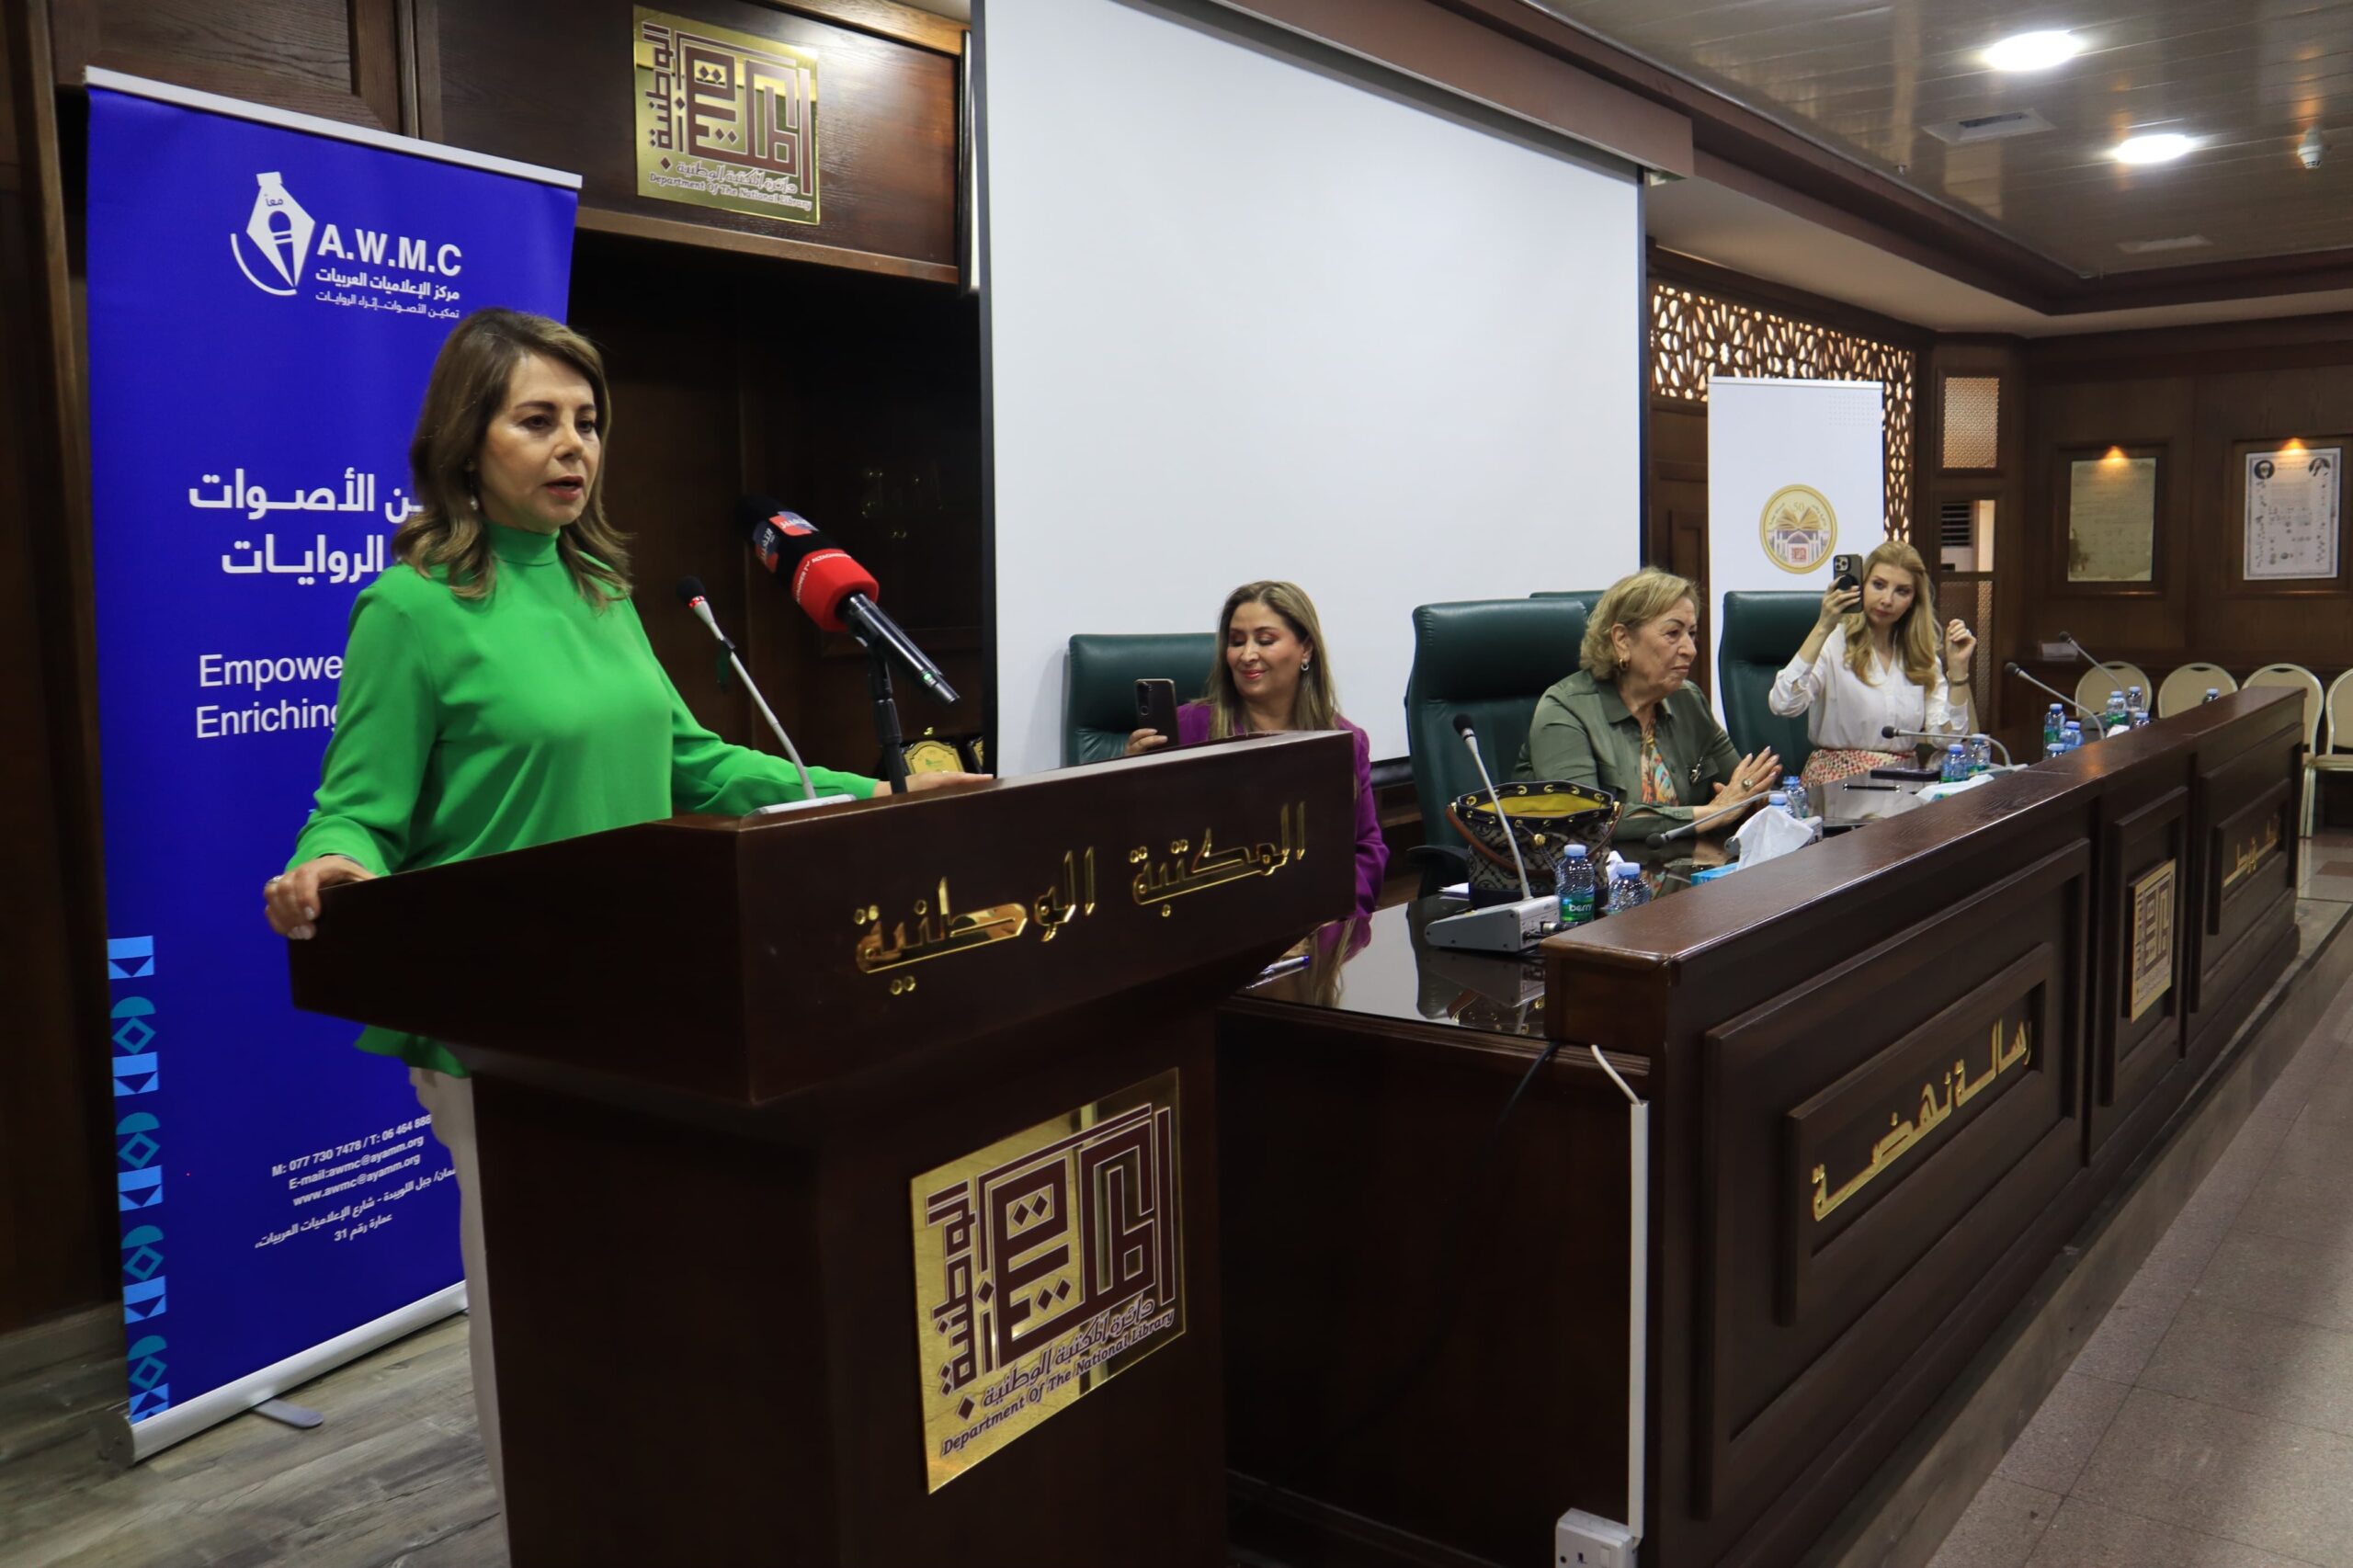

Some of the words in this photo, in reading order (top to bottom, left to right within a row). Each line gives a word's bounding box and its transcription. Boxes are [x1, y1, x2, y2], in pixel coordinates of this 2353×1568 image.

[649, 171, 706, 191] Department
[707, 182, 720, 196] Of
[721, 184, 738, 197] The
[738, 187, 779, 204] National
[779, 194, 813, 211] Library
[316, 223, 462, 277] A.W.M.C
[315, 267, 367, 288] العربيات
[433, 284, 460, 301] مركز
[199, 653, 344, 691] Empowe
[1130, 800, 1306, 917] المكتبة
[856, 846, 1096, 995] الوطنية
[289, 1155, 311, 1171] 077
[313, 1149, 334, 1164] 730
[334, 1228, 347, 1242] 31
[1110, 1292, 1155, 1334] دائرة
[1055, 1309, 1111, 1366] المكتبة
[941, 1395, 1025, 1459] Department
[1029, 1381, 1046, 1403] Of
[1047, 1371, 1072, 1392] The
[1075, 1339, 1129, 1377] National
[1131, 1309, 1176, 1344] Library
[983, 1343, 1052, 1408] الوطنية
